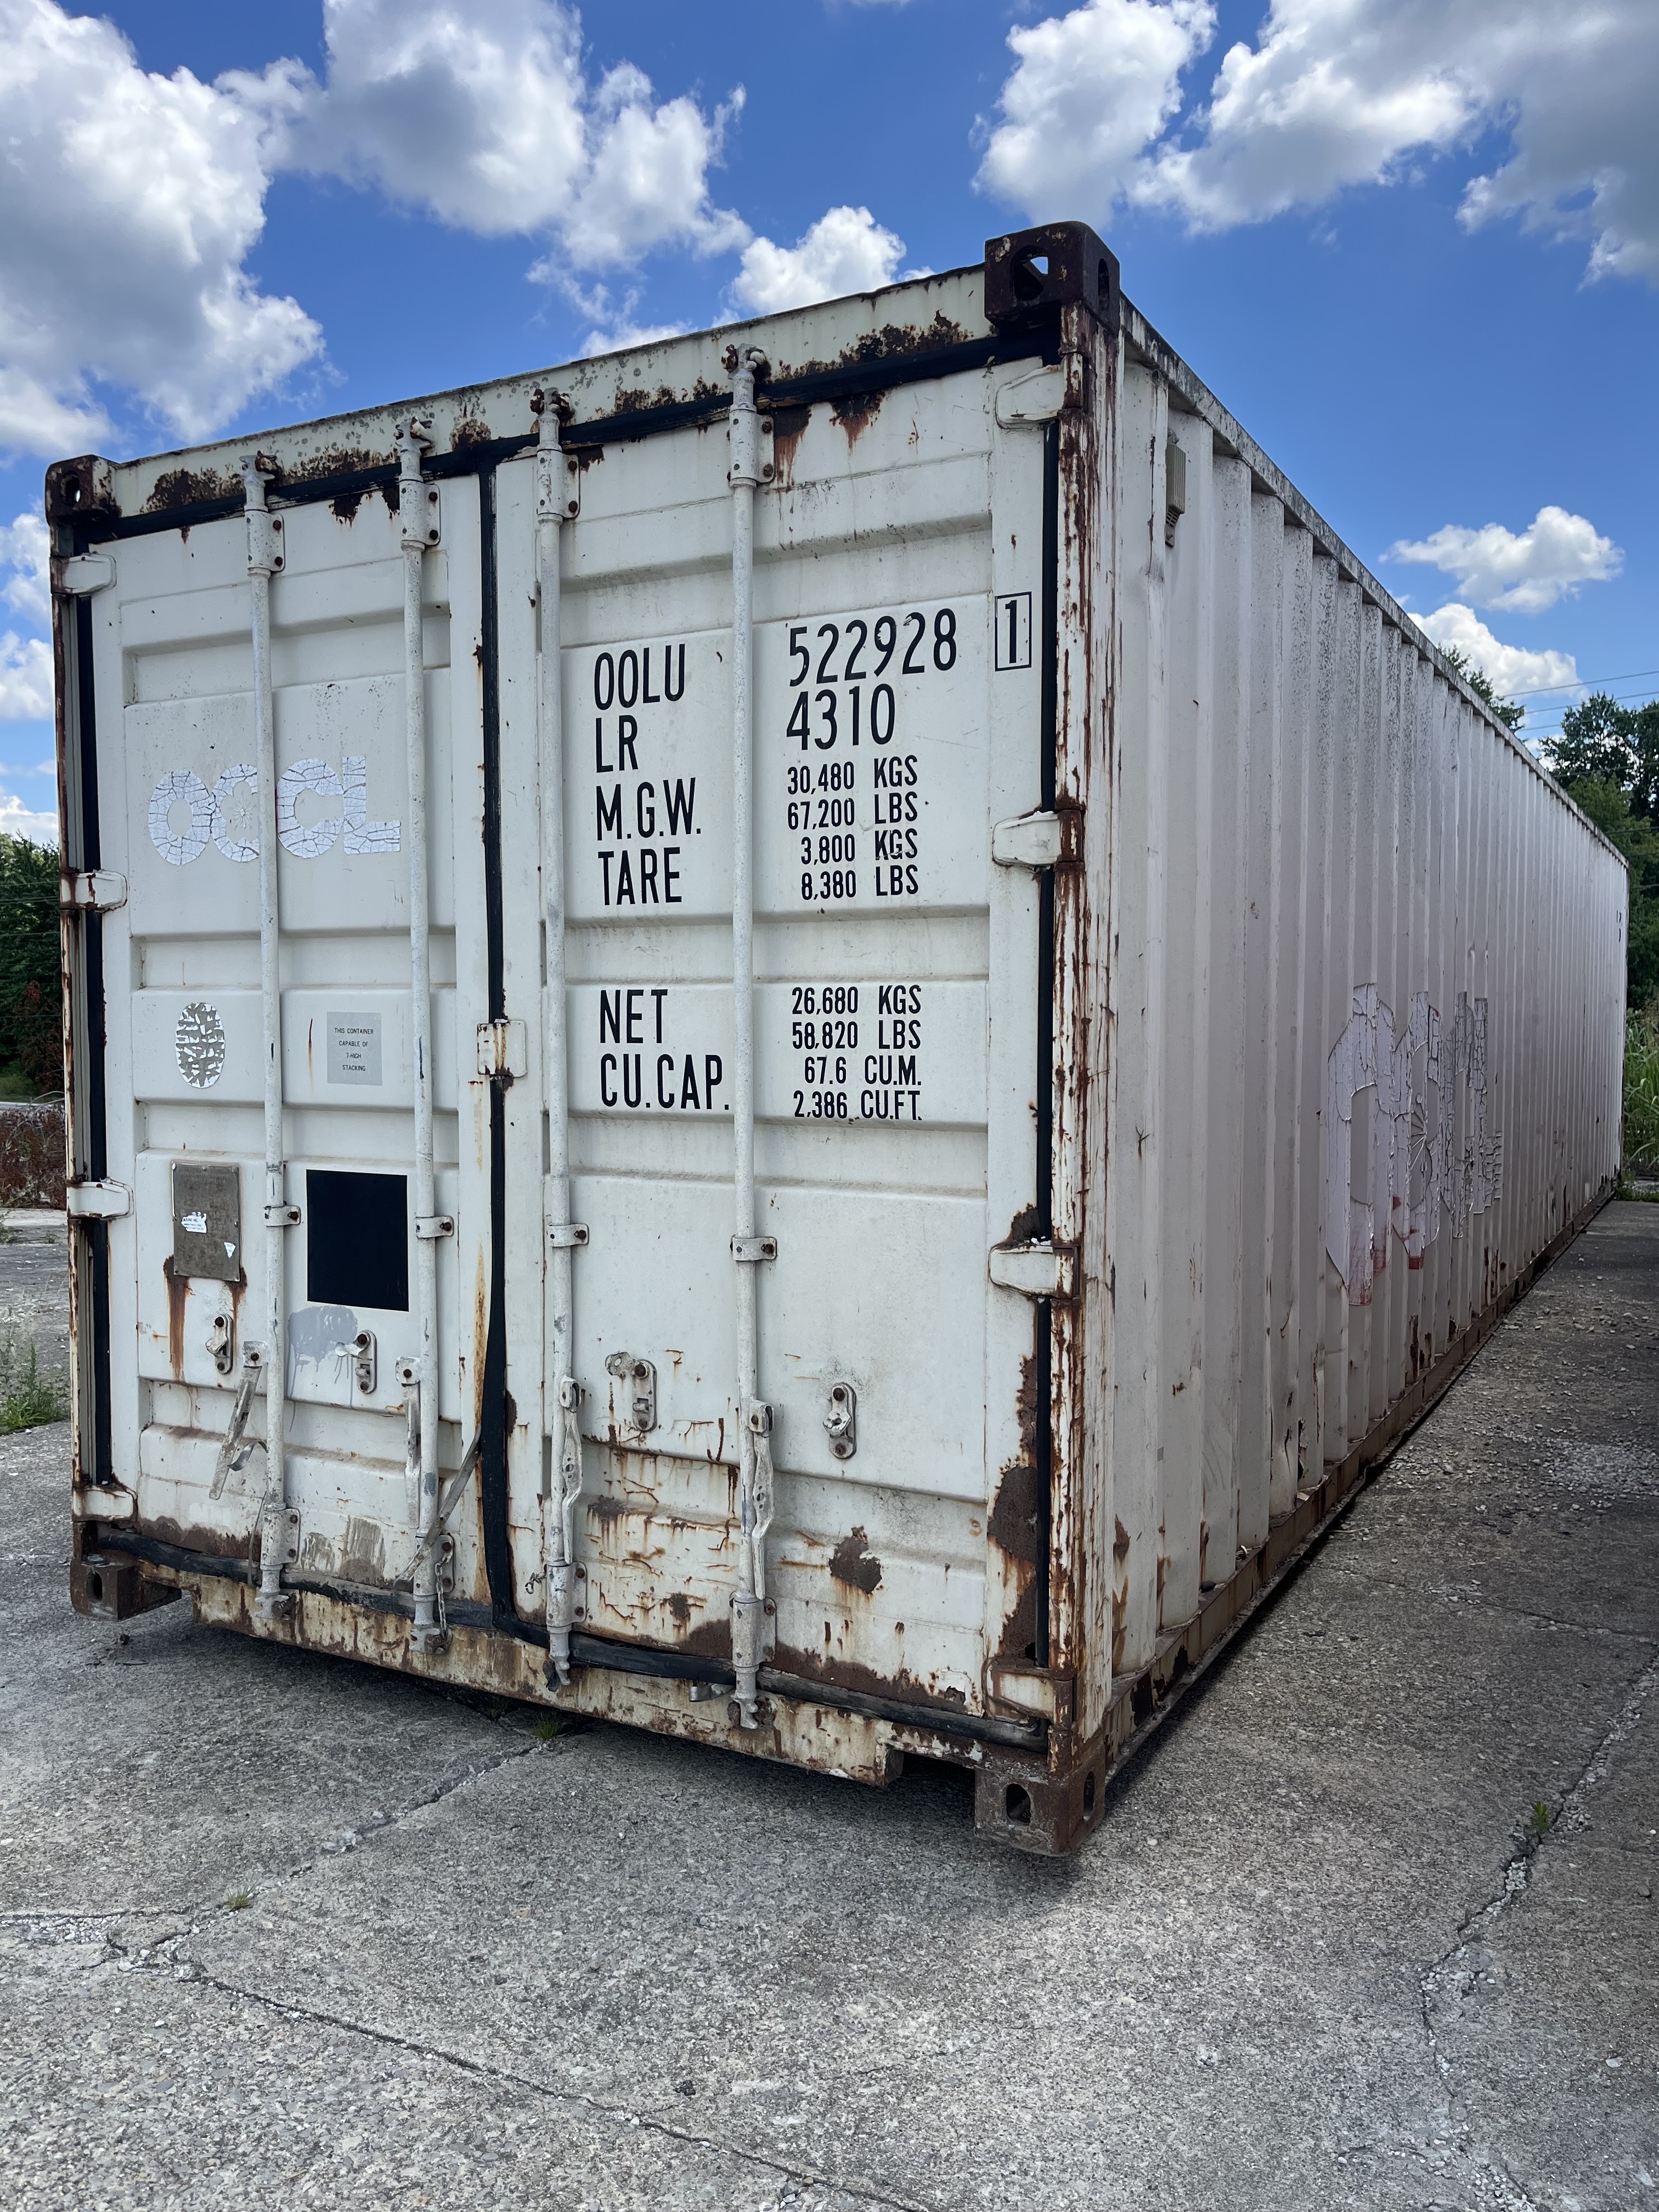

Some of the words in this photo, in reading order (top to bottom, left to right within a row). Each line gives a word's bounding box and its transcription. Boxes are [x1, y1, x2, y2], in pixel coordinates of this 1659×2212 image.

[594, 643, 685, 710] OOLU
[789, 608, 957, 686] 522928
[1005, 599, 1017, 664] 1
[595, 715, 639, 774] LR
[786, 682, 895, 751] 4310
[787, 761, 854, 795] 30,480
[874, 754, 918, 789] KGS
[788, 798, 855, 830] 67,200
[874, 791, 918, 825] LBS
[597, 847, 682, 906] TARE
[801, 834, 855, 865] 3,800
[874, 828, 918, 861] KGS
[801, 870, 856, 900] 8,380
[876, 864, 919, 896] LBS
[600, 989, 668, 1044] NET
[792, 986, 858, 1015] 26,680
[878, 984, 921, 1015] KGS
[792, 1020, 858, 1049] 58,820
[878, 1019, 921, 1049] LBS
[804, 1056, 847, 1085] 67.6
[793, 1090, 848, 1119] 2,386
